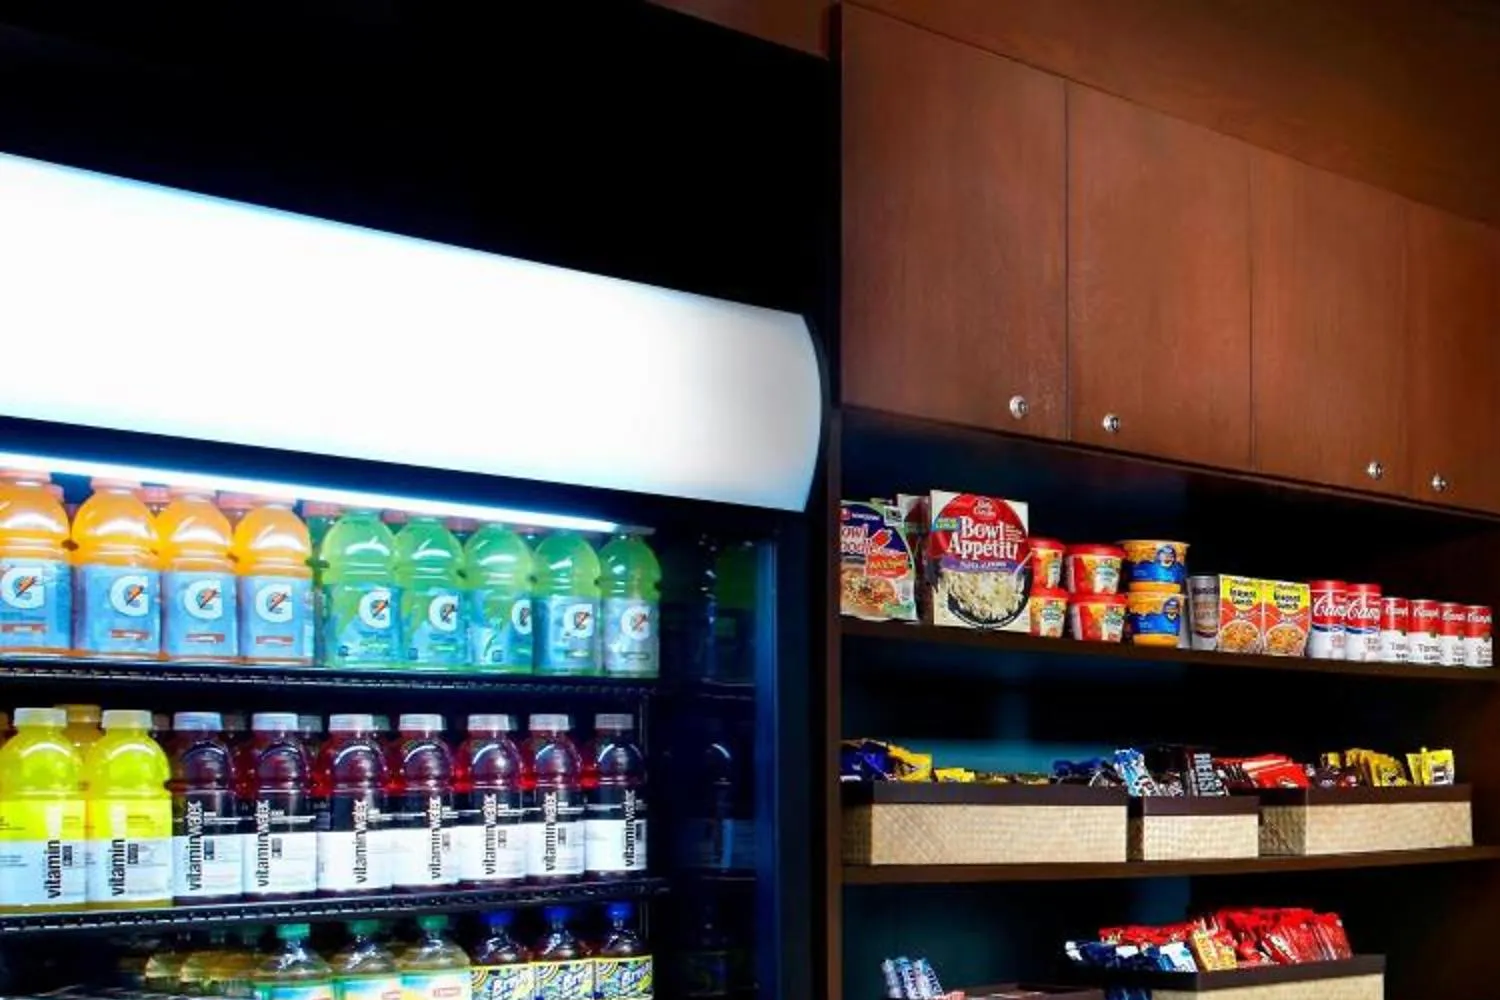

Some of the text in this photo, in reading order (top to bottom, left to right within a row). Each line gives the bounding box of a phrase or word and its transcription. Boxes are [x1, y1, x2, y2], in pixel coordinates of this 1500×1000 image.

[959, 516, 1005, 541] Bowl
[1, 567, 45, 609] G
[110, 575, 149, 617] G
[184, 579, 223, 620] G
[255, 583, 293, 623] G
[358, 587, 391, 629] G
[428, 595, 460, 631] G
[562, 603, 593, 639] G
[620, 605, 650, 640] G
